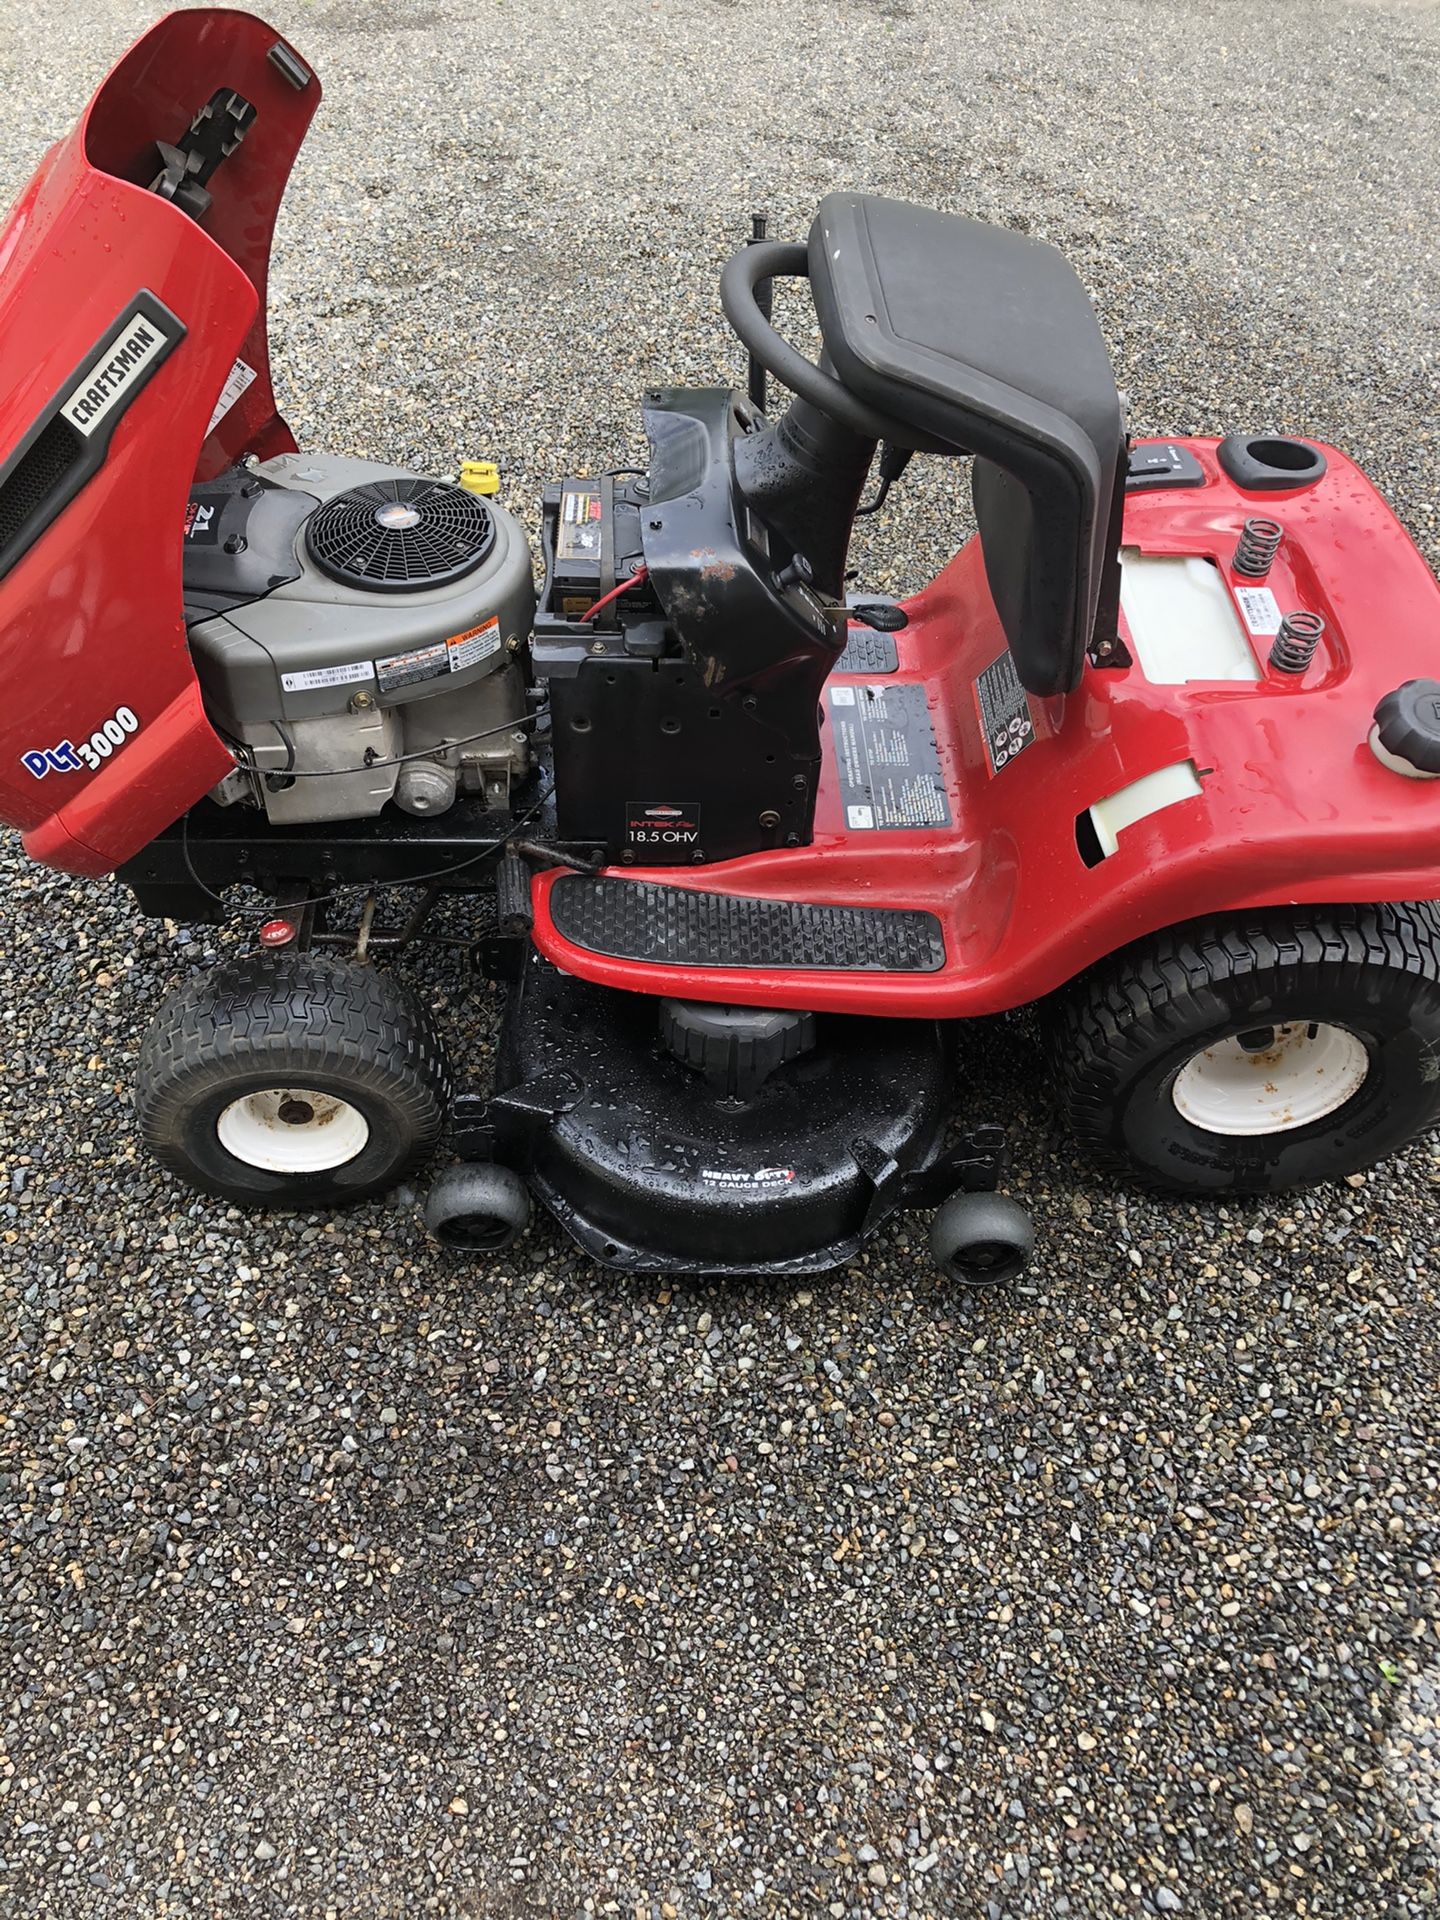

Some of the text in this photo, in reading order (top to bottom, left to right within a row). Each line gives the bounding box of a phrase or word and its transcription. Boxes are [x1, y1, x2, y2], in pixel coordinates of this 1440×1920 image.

[72, 326, 155, 425] CRAFTSMAN
[193, 505, 215, 535] 21
[461, 621, 493, 642] WARNING
[20, 706, 139, 780] DLT 3000
[630, 820, 674, 828] INTEK
[629, 831, 698, 842] 18.5 OHV
[702, 1169, 790, 1181] HEAVY DUTY
[703, 1178, 793, 1189] 12 GAUGE DECK
